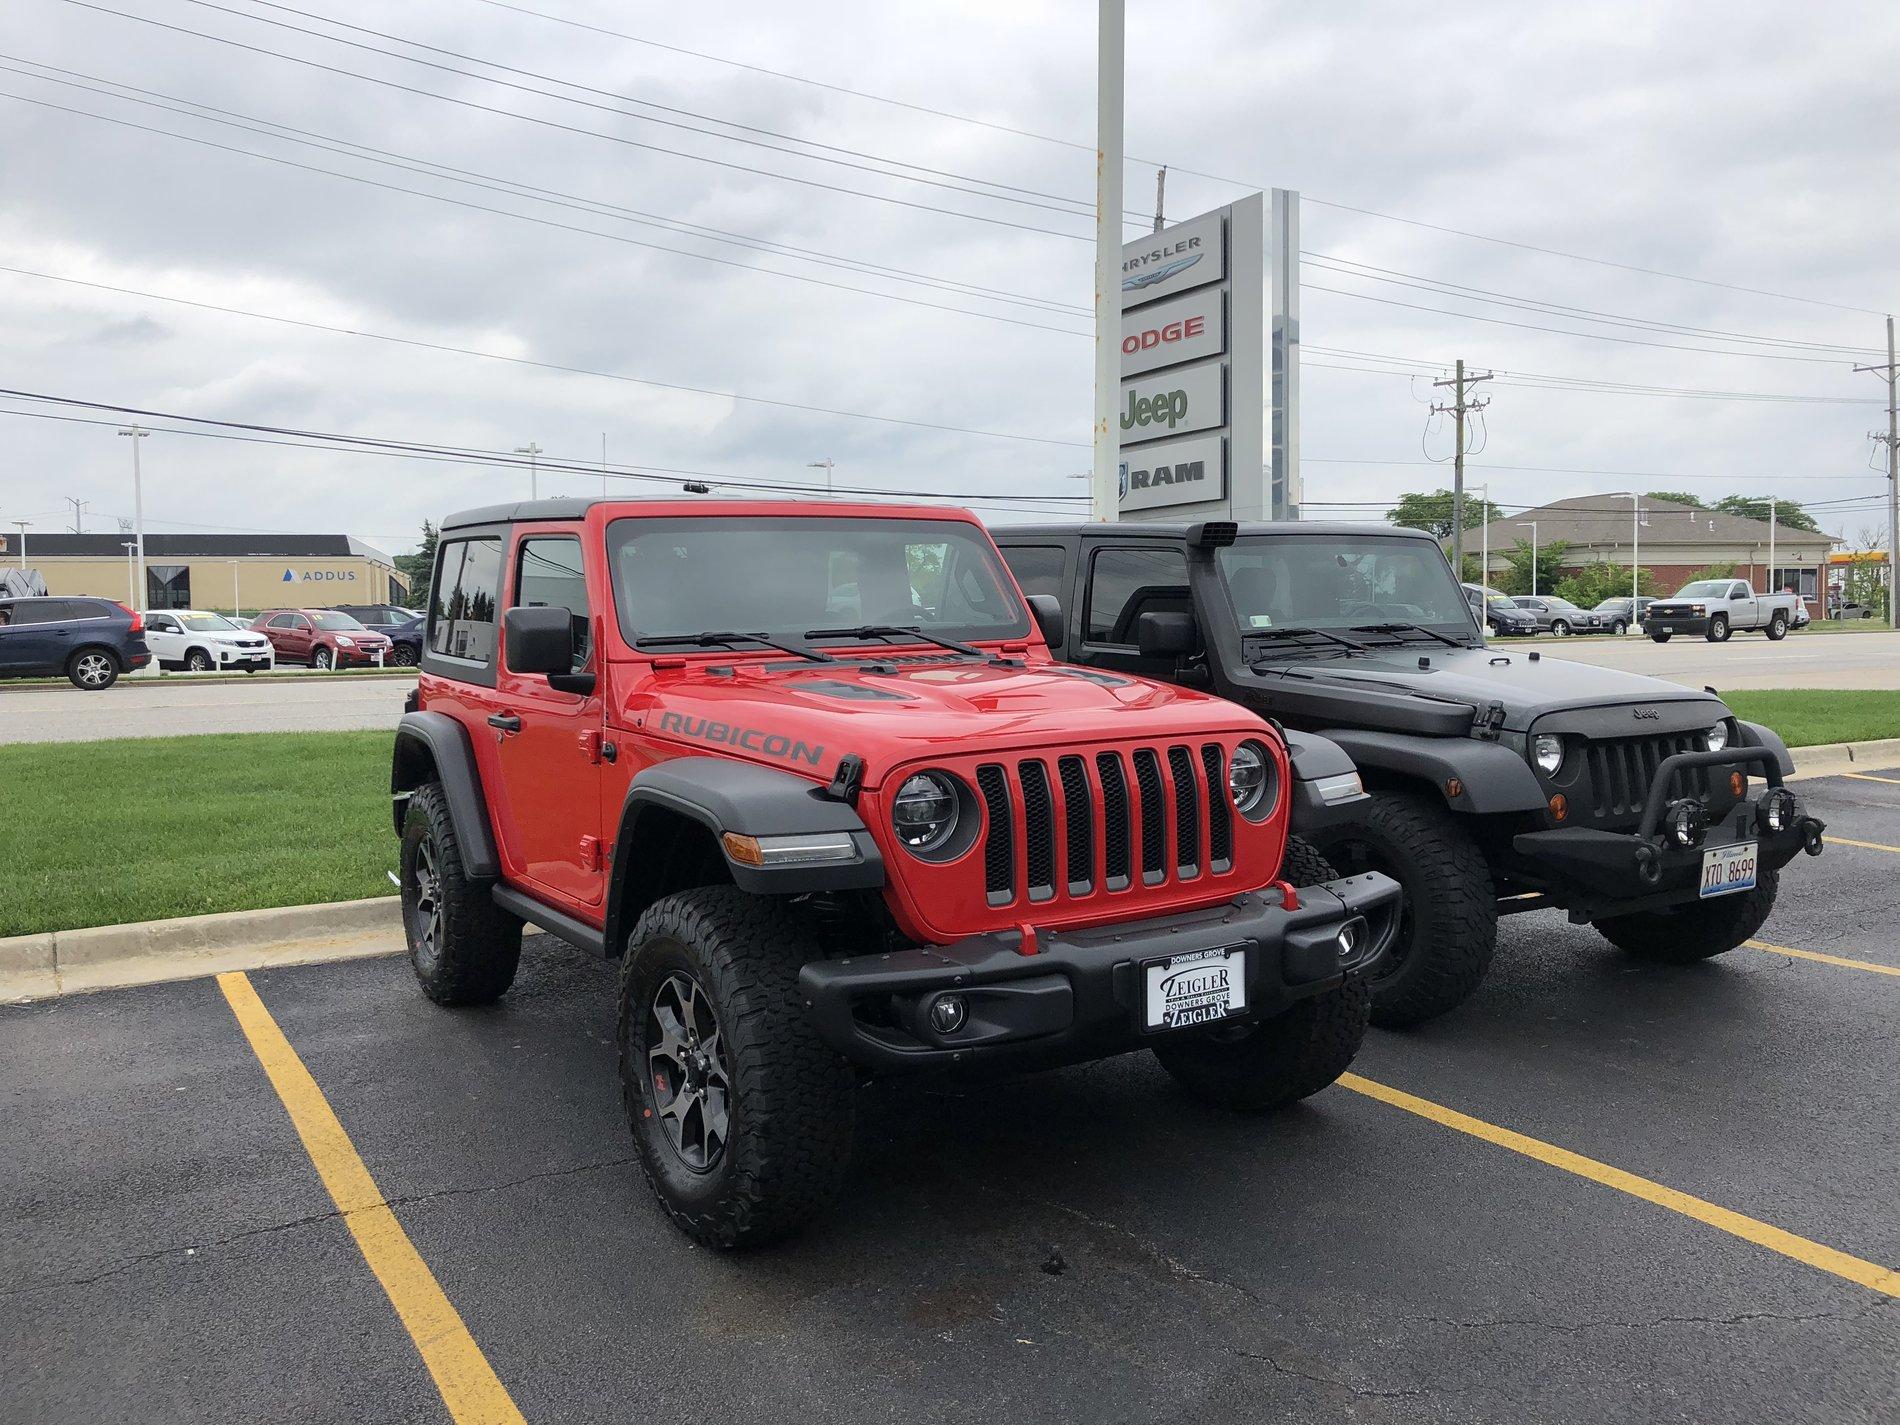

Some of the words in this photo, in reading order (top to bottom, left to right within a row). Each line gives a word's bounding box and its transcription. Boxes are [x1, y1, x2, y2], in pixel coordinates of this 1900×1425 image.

[1122, 236, 1202, 273] HRYSLER
[1122, 315, 1205, 355] ODGE
[1120, 388, 1188, 430] Jeep
[1130, 460, 1205, 491] RAM
[303, 571, 356, 581] ADDUS
[1634, 707, 1660, 720] Jeep
[660, 711, 826, 766] RUBICON
[1704, 863, 1723, 888] X70
[1728, 857, 1755, 883] 8699
[1171, 952, 1203, 964] DOWNERS
[1203, 948, 1226, 959] GROVE
[1165, 969, 1230, 998] ZEIGLER
[1165, 996, 1204, 1012] DOWNERS
[1206, 992, 1230, 1004] GROVE
[1170, 1002, 1227, 1028] ZEIGLER
